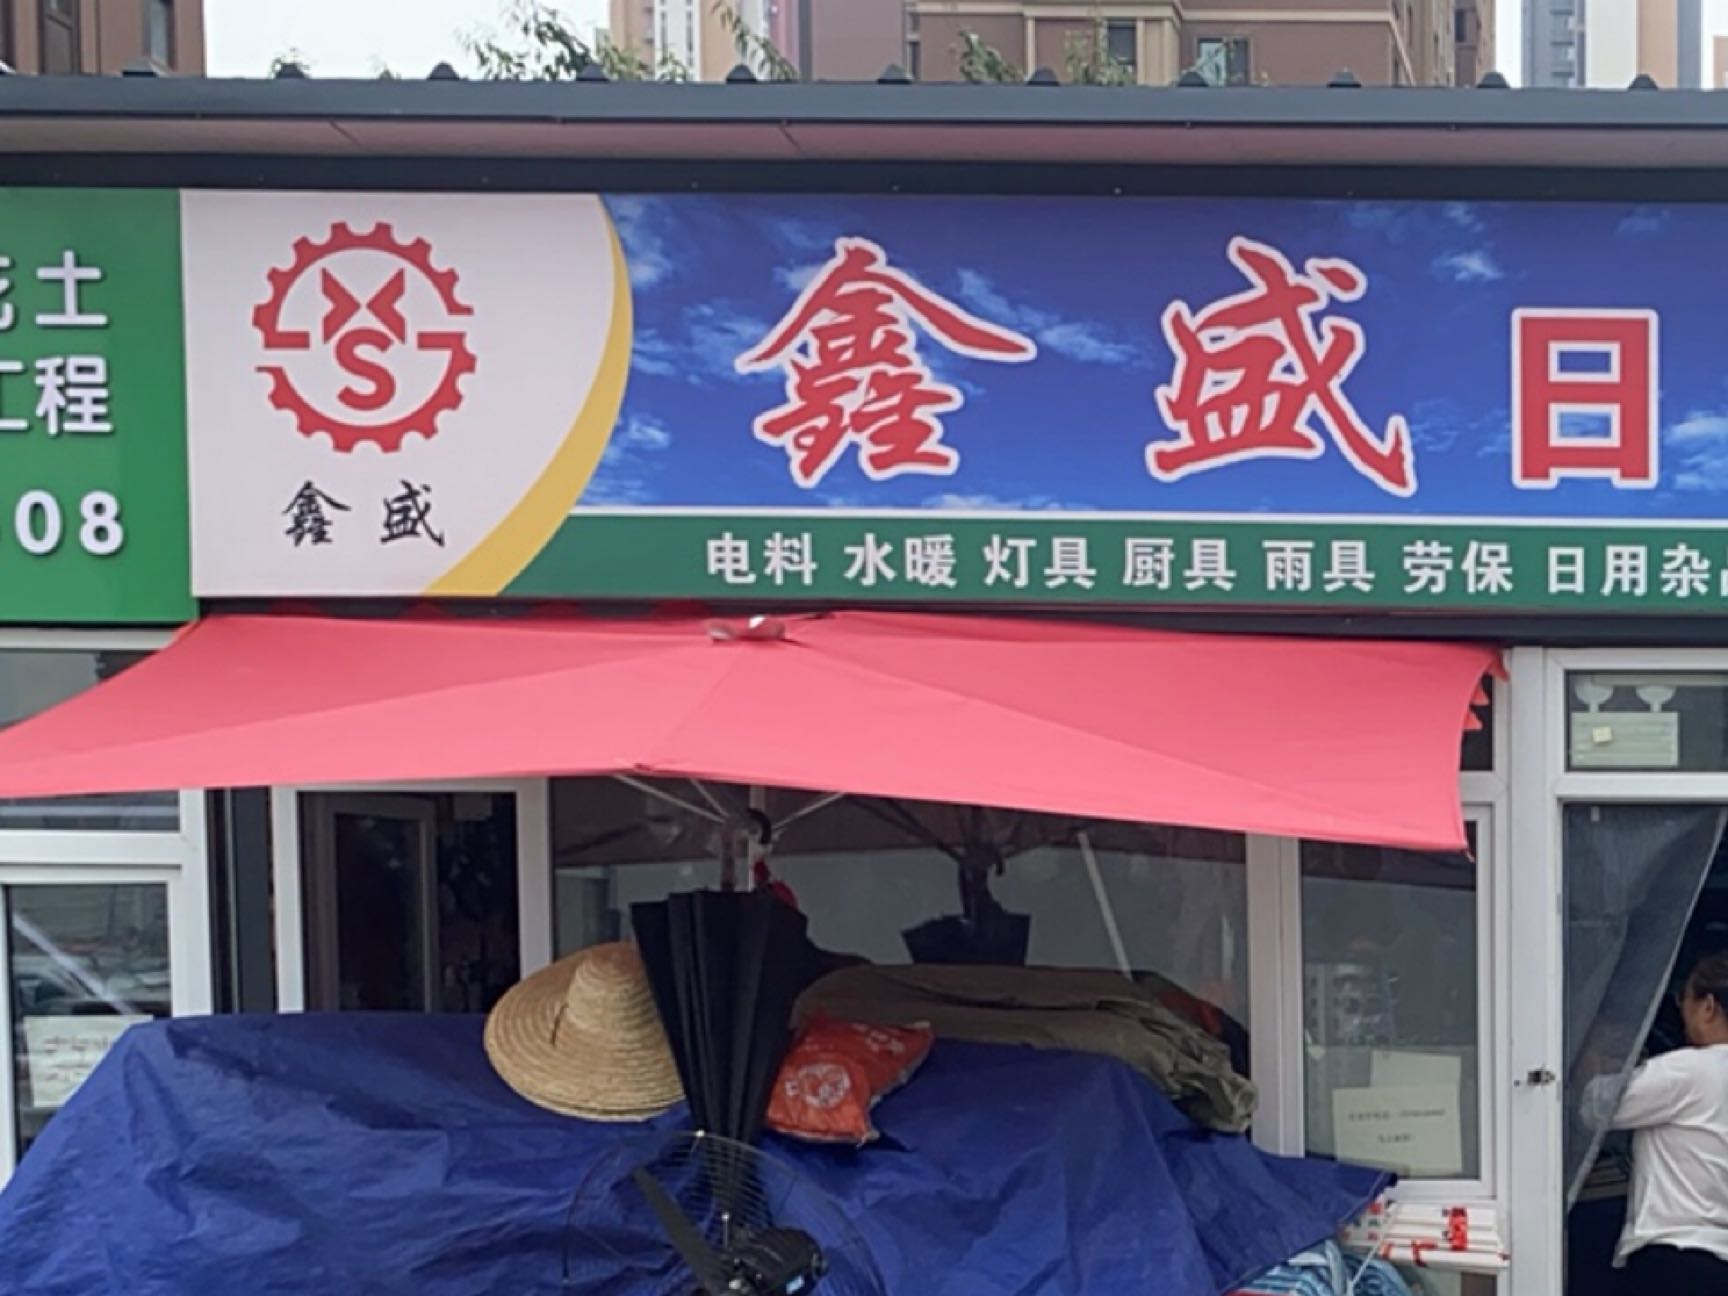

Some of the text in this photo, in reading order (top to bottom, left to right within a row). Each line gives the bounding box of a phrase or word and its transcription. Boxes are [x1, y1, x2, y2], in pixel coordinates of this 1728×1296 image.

[282, 480, 446, 547] 鑫盛
[704, 532, 818, 586] 电料
[842, 533, 959, 589] 水暖
[983, 537, 1097, 588] 灯具
[1123, 538, 1237, 590] 厨具
[1261, 538, 1376, 592] 雨具
[1402, 541, 1514, 594] 劳保
